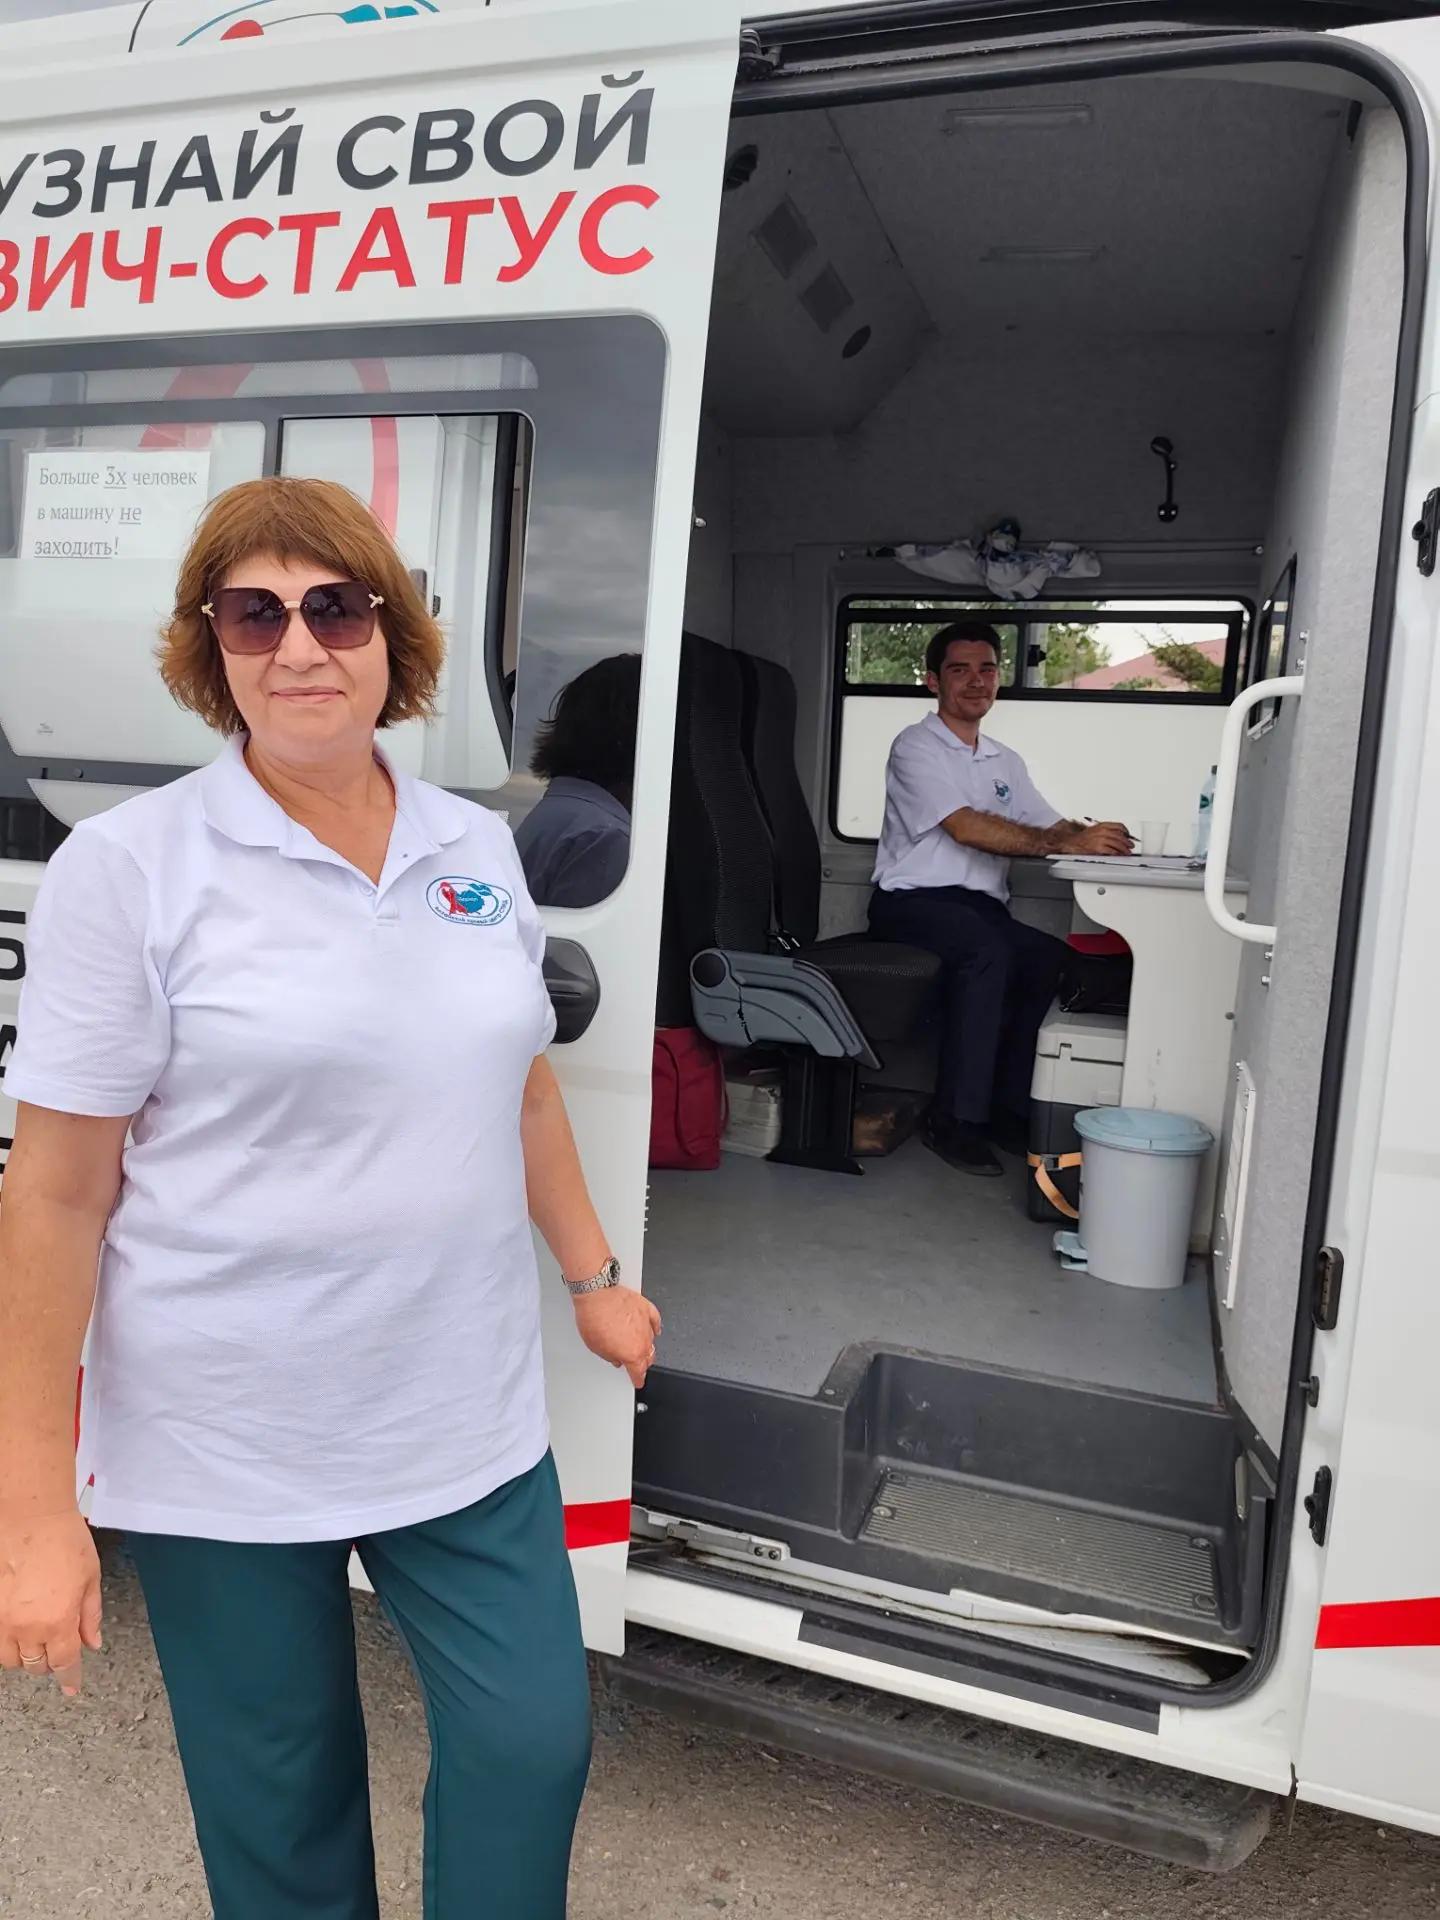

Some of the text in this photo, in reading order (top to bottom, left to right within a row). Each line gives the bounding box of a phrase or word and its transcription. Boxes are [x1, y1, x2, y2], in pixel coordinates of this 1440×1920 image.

[0, 69, 655, 219] УЗНАЙ СВОЙ
[39, 466, 197, 488] Больше 3х человек
[37, 507, 142, 524] в машину не
[34, 536, 119, 558] заходить!
